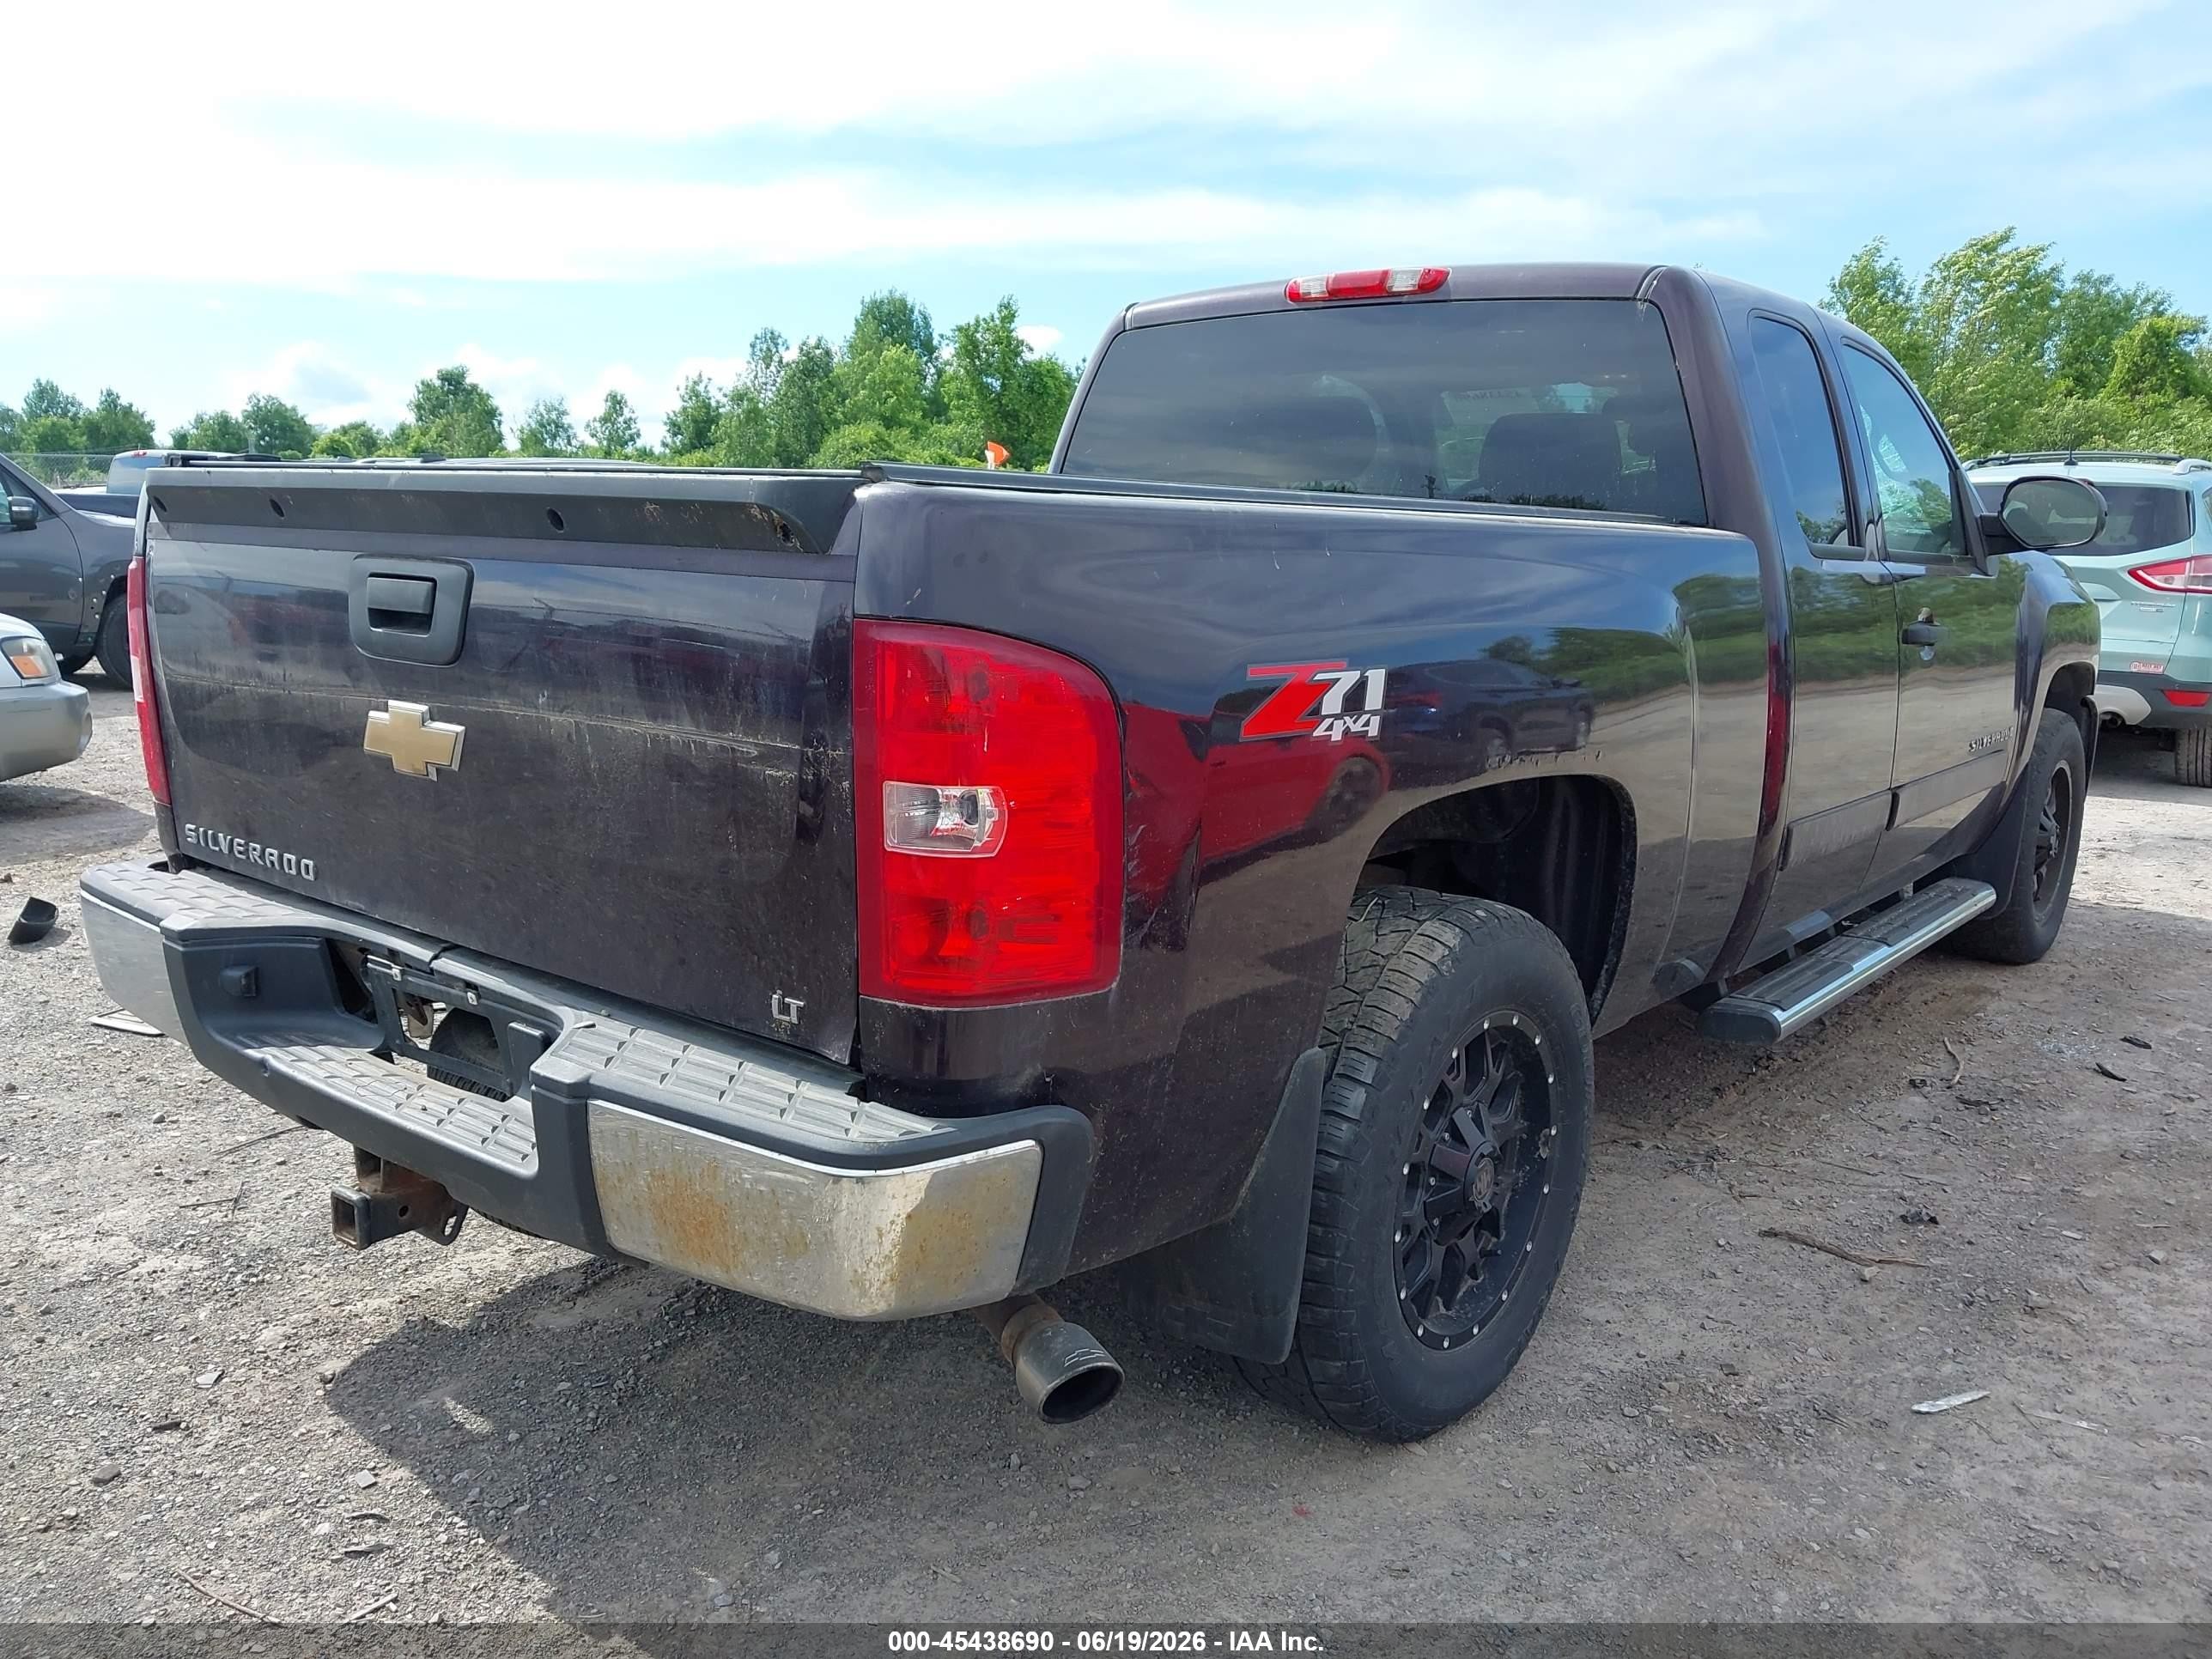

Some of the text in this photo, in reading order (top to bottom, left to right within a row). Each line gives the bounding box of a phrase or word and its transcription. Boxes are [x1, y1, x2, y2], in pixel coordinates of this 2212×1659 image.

[1243, 660, 1387, 738] Z71
[184, 823, 316, 882] SILVERADO
[771, 994, 805, 1024] LT
